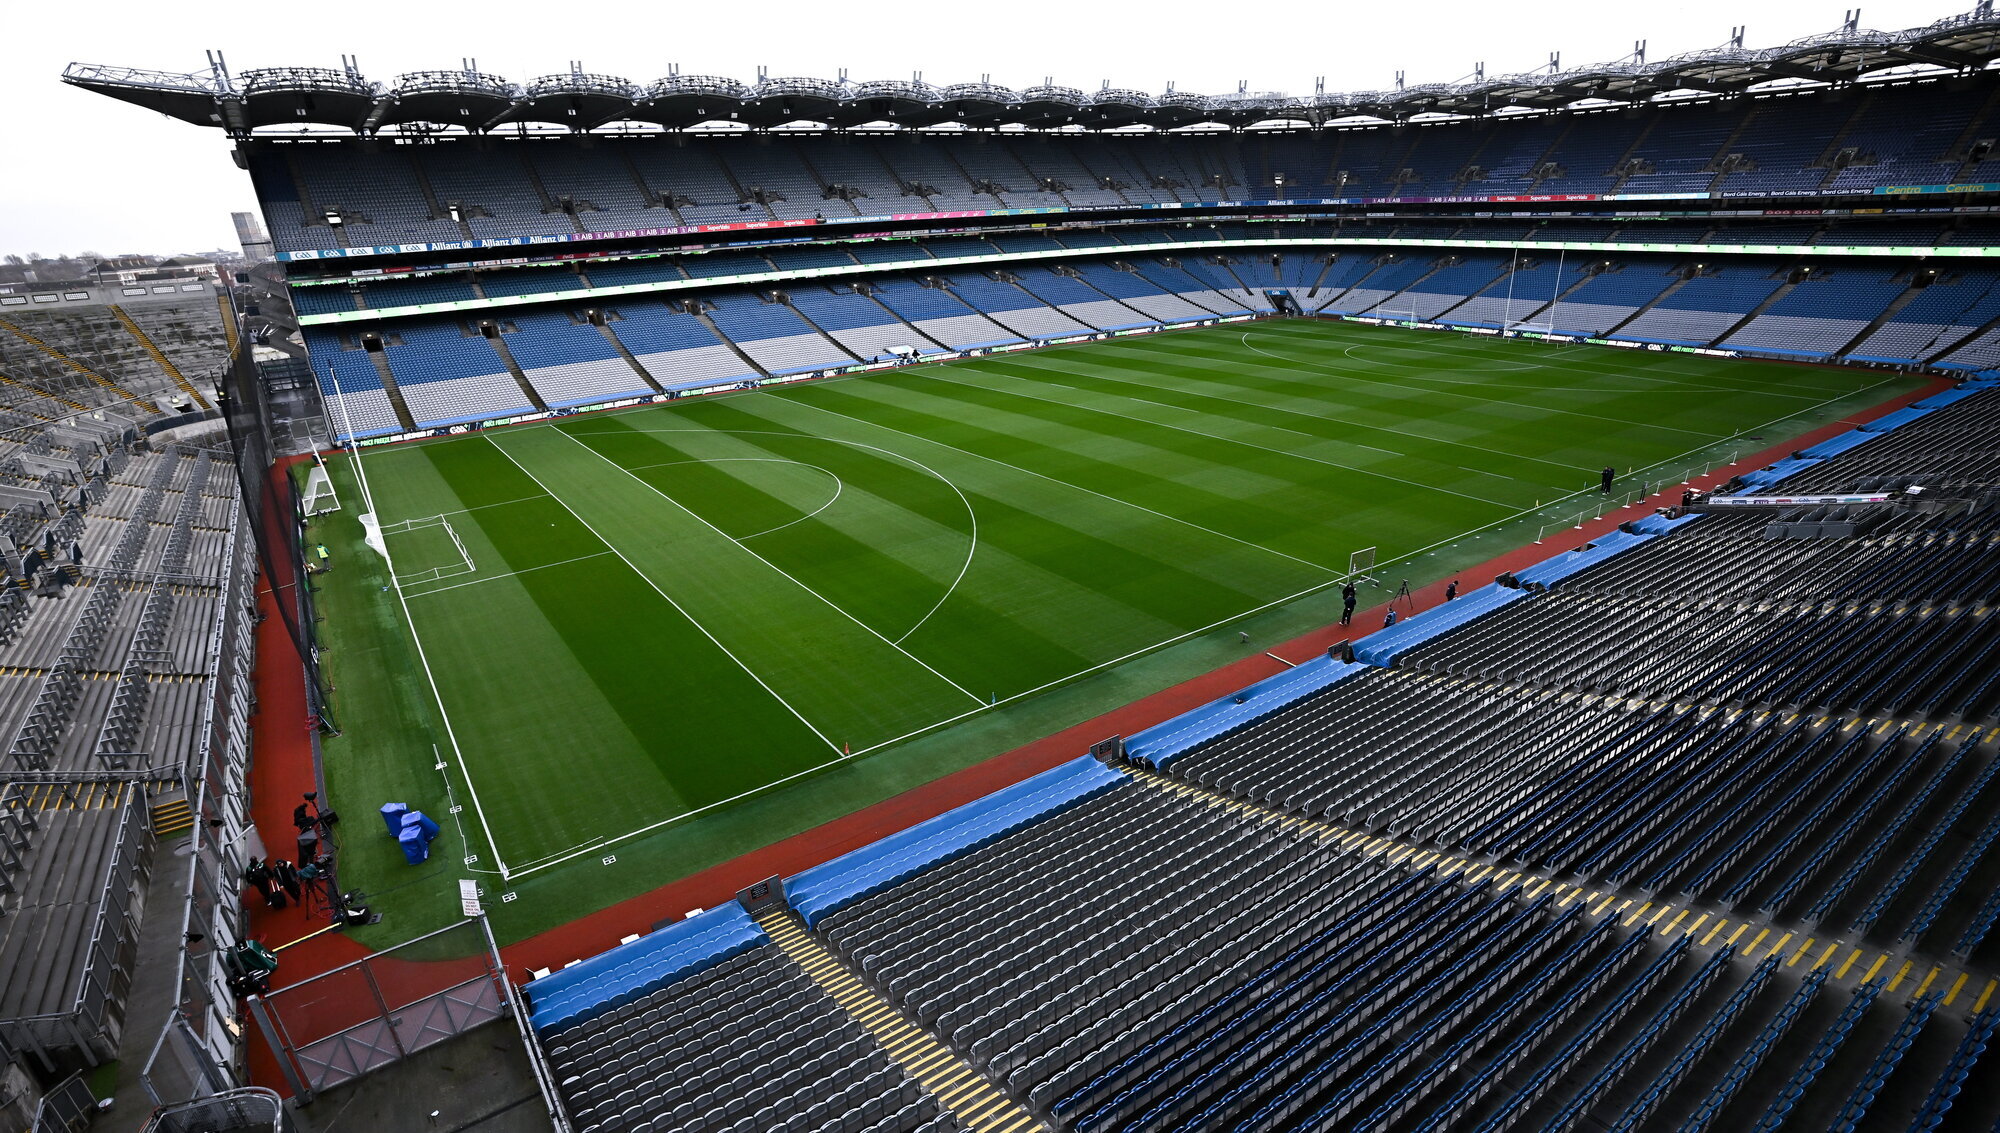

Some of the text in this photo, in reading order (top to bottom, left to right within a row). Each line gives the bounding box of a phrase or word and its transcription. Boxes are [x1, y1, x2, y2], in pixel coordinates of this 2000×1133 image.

[1886, 186, 1922, 194] Centra
[1946, 184, 1984, 192] Centra
[481, 239, 510, 247] Allianz
[529, 236, 557, 244] Allianz
[432, 241, 461, 250] Allianz
